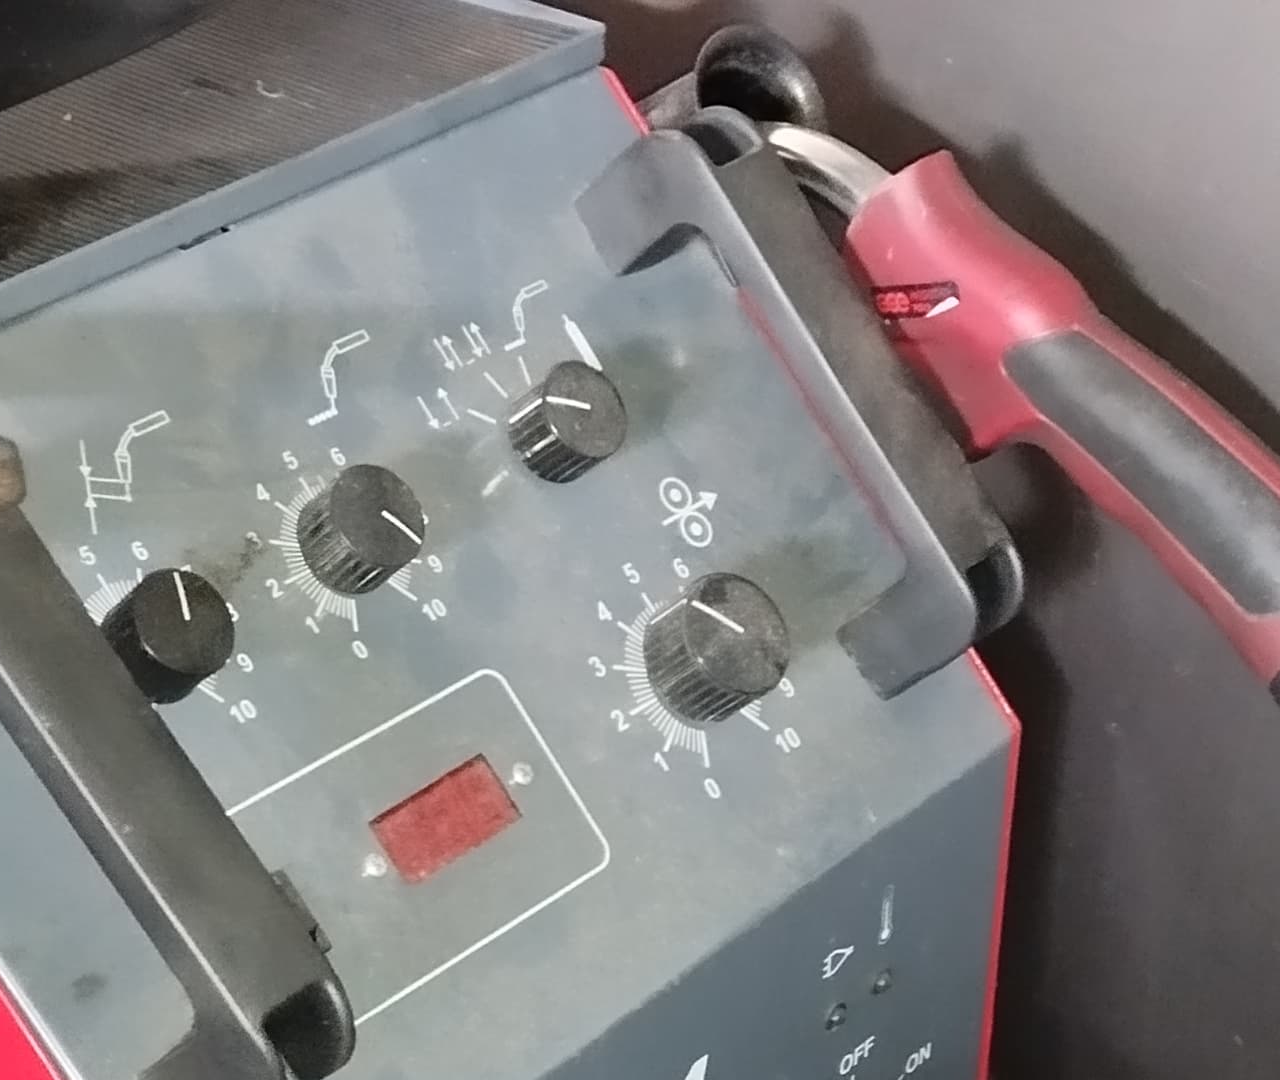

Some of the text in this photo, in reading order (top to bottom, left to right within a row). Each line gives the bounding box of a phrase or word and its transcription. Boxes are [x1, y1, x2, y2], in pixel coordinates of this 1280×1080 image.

[282, 450, 299, 470] 5
[330, 447, 346, 466] 6
[256, 483, 271, 501] 4
[78, 545, 97, 566] 5
[131, 541, 149, 561] 6
[427, 554, 443, 573] 9
[621, 562, 641, 584] 5
[673, 557, 690, 579] 6
[266, 579, 284, 599] 2
[422, 598, 447, 621] 10
[597, 601, 613, 621] 4
[305, 615, 320, 634] 1
[351, 640, 369, 659] 0
[236, 653, 254, 673] 9
[588, 656, 607, 678] 3
[778, 677, 795, 698] 9
[229, 699, 257, 724] 10
[610, 709, 630, 732] 2
[775, 727, 801, 753] 10
[653, 752, 669, 771] 1
[703, 778, 721, 799] 0
[840, 1036, 875, 1075] OFF
[905, 1042, 932, 1074] ON
